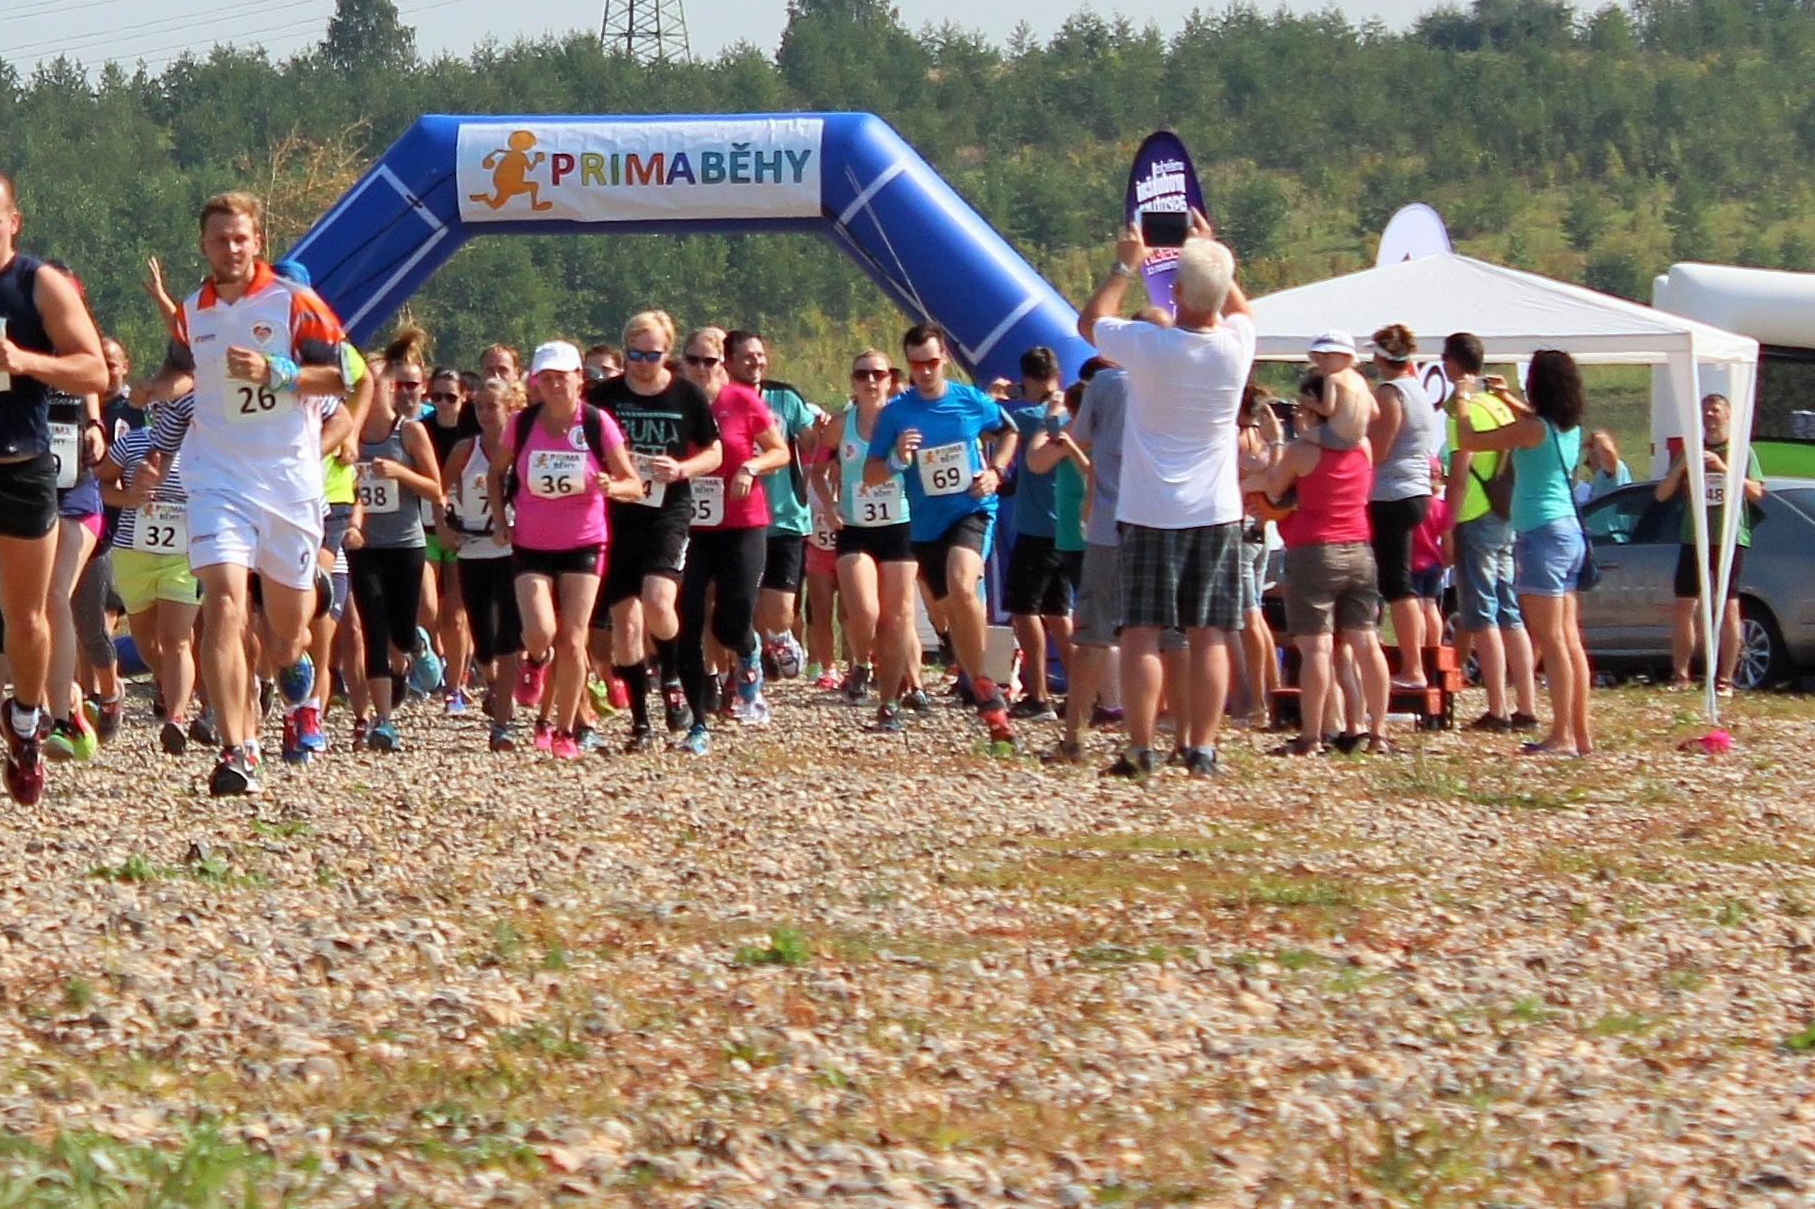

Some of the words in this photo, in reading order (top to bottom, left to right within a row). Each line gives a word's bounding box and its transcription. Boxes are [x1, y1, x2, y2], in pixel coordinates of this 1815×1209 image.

[551, 143, 812, 186] PRIMABĚHY
[237, 386, 276, 414] 26
[541, 475, 572, 494] 36
[932, 467, 961, 489] 69
[864, 503, 891, 521] 31
[145, 526, 175, 547] 32
